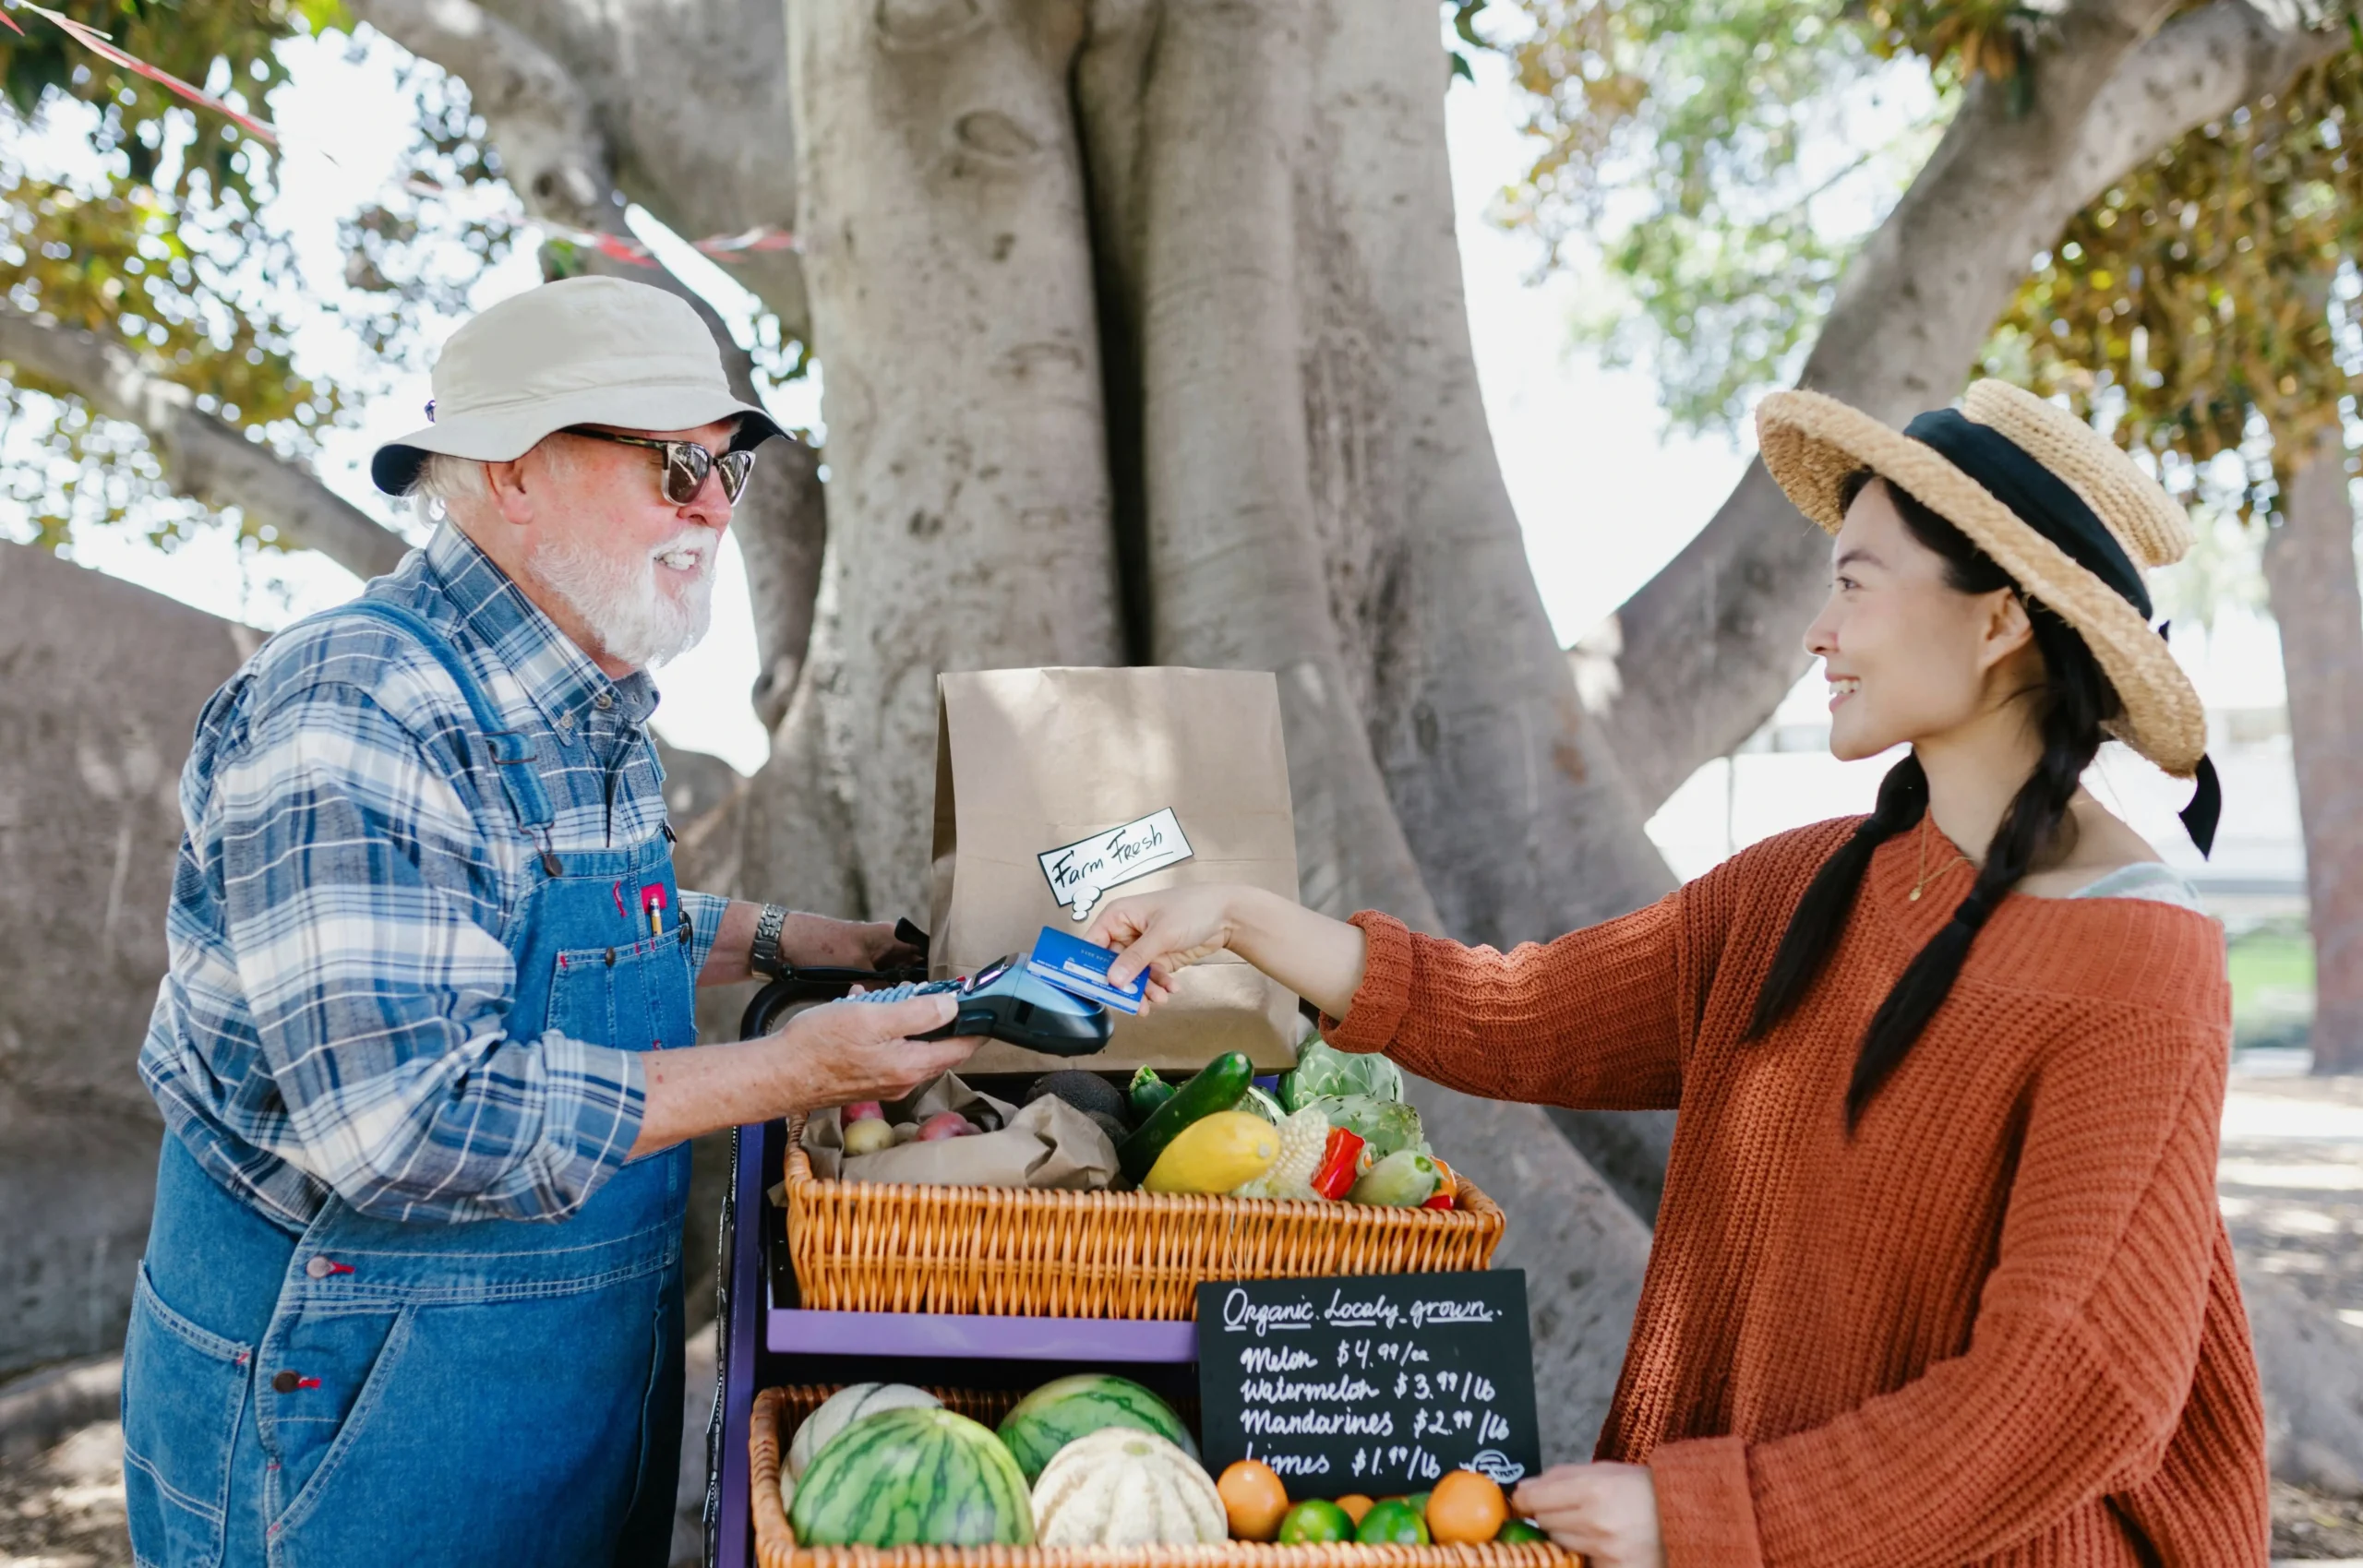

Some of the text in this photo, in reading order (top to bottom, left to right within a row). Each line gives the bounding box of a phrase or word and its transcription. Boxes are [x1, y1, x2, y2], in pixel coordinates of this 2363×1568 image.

[1052, 850, 1103, 888] Farm
[1240, 1345, 1318, 1373] Melon
[1239, 1406, 1394, 1435] Mandarines
